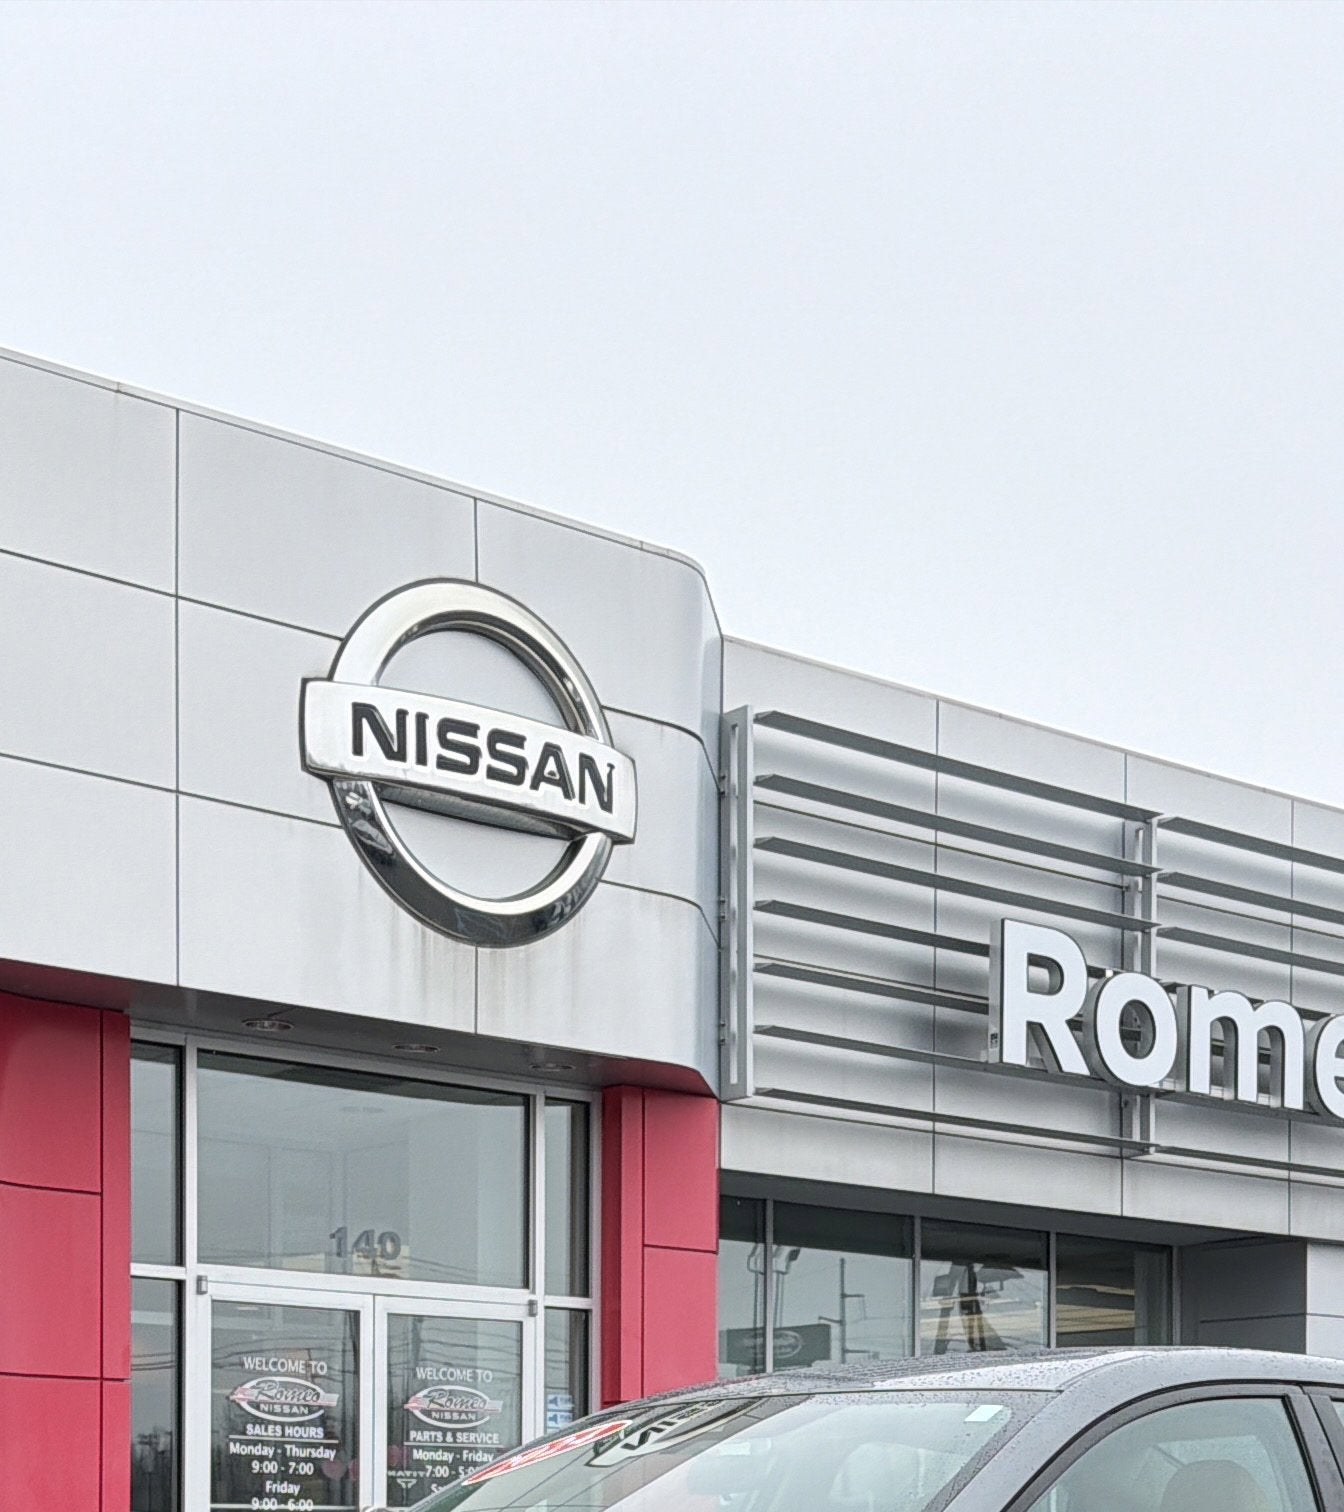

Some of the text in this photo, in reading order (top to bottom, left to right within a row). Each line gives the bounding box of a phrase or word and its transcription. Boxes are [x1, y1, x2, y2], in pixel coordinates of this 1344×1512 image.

[351, 701, 615, 815] NISSAN
[329, 1226, 402, 1261] 140
[243, 1356, 328, 1375] WELCOME TO
[416, 1367, 493, 1383] WELCOME TO
[252, 1380, 321, 1402] Romeo
[422, 1388, 487, 1409] Romeo
[259, 1403, 309, 1415] NISSAN
[430, 1411, 476, 1421] NISSAN
[246, 1423, 324, 1439] SALES HOURS
[409, 1430, 499, 1444] PARTS & SERVICE
[229, 1442, 275, 1458] Monday
[284, 1444, 336, 1461] Thursday
[412, 1449, 454, 1463] Monday
[462, 1450, 494, 1463] Friday
[251, 1460, 278, 1473] 9:00
[288, 1462, 314, 1475] 7:00
[425, 1465, 450, 1478] 7:00
[265, 1480, 300, 1496] Friday
[251, 1497, 278, 1511] 9:00
[287, 1499, 314, 1512] 6:00
